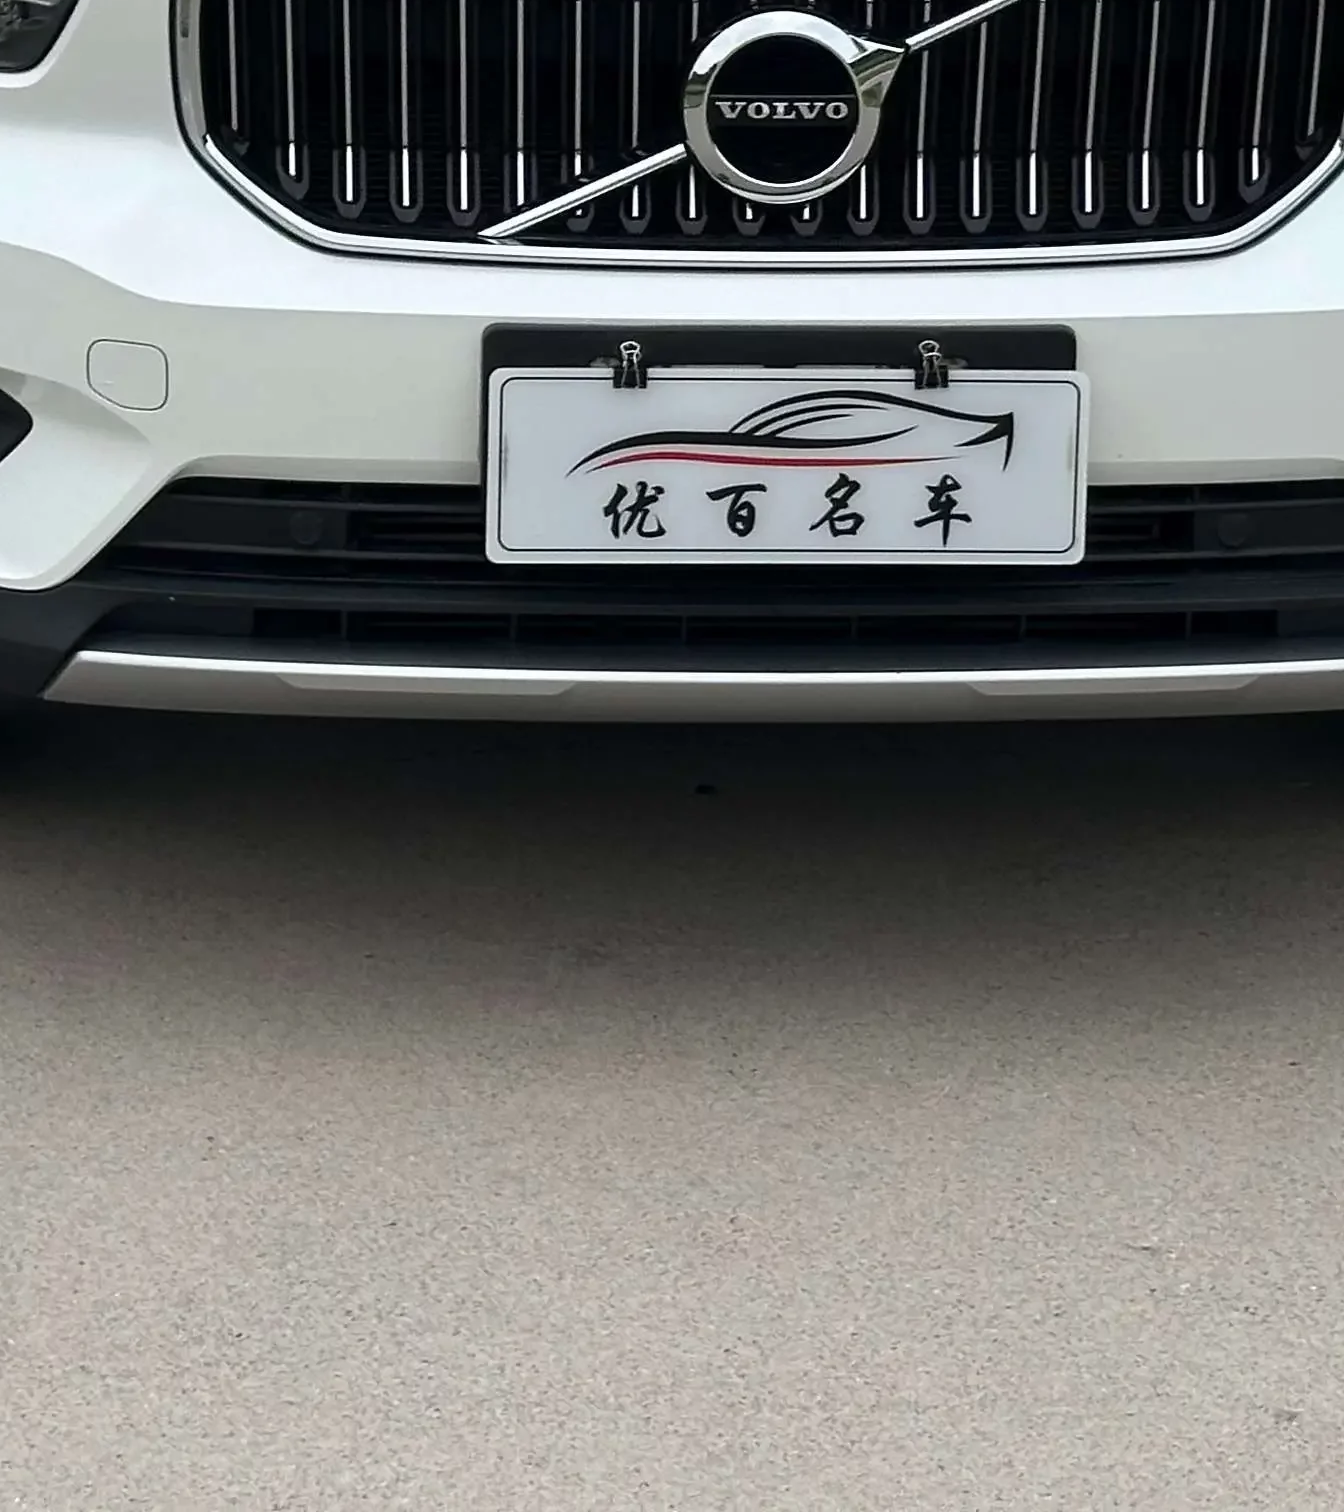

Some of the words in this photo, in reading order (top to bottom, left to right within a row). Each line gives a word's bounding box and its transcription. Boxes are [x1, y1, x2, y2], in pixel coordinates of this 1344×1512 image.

[714, 101, 849, 120] VOLVO
[602, 472, 973, 548] 优百名车
